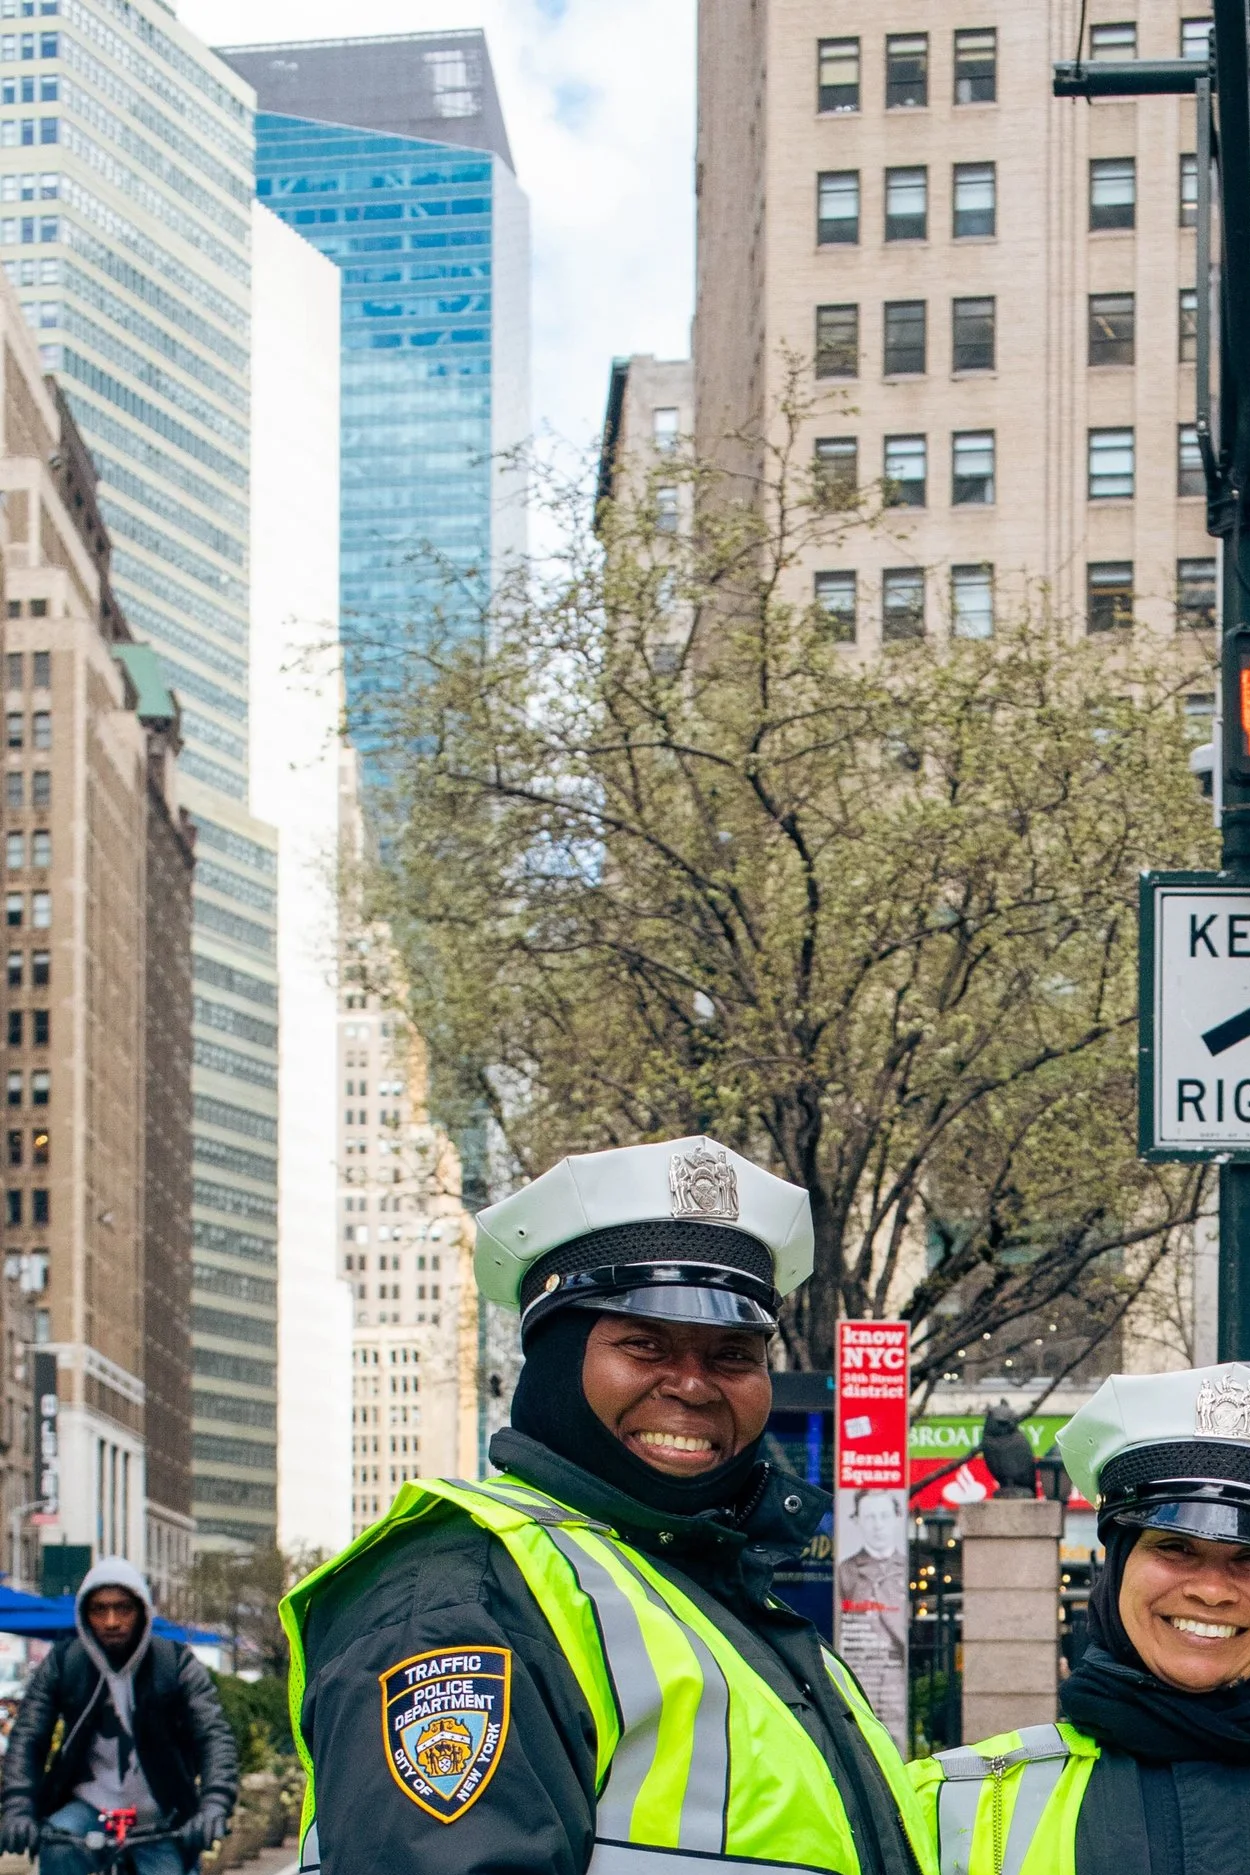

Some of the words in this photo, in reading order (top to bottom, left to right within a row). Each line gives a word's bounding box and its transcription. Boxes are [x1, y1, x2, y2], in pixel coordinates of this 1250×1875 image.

[842, 1325, 905, 1345] know
[842, 1347, 905, 1369] NYC
[842, 1383, 904, 1399] district
[908, 1425, 1046, 1447] BROAY
[842, 1450, 901, 1466] Herald
[842, 1467, 901, 1486] Square
[404, 1655, 482, 1685] TRAFFIC
[413, 1680, 474, 1706] POLICE
[394, 1695, 495, 1731] DEPARTMENT
[394, 1748, 417, 1778] CITY
[413, 1778, 434, 1797] OF
[456, 1768, 483, 1802] NEW
[477, 1722, 501, 1765] YORK
